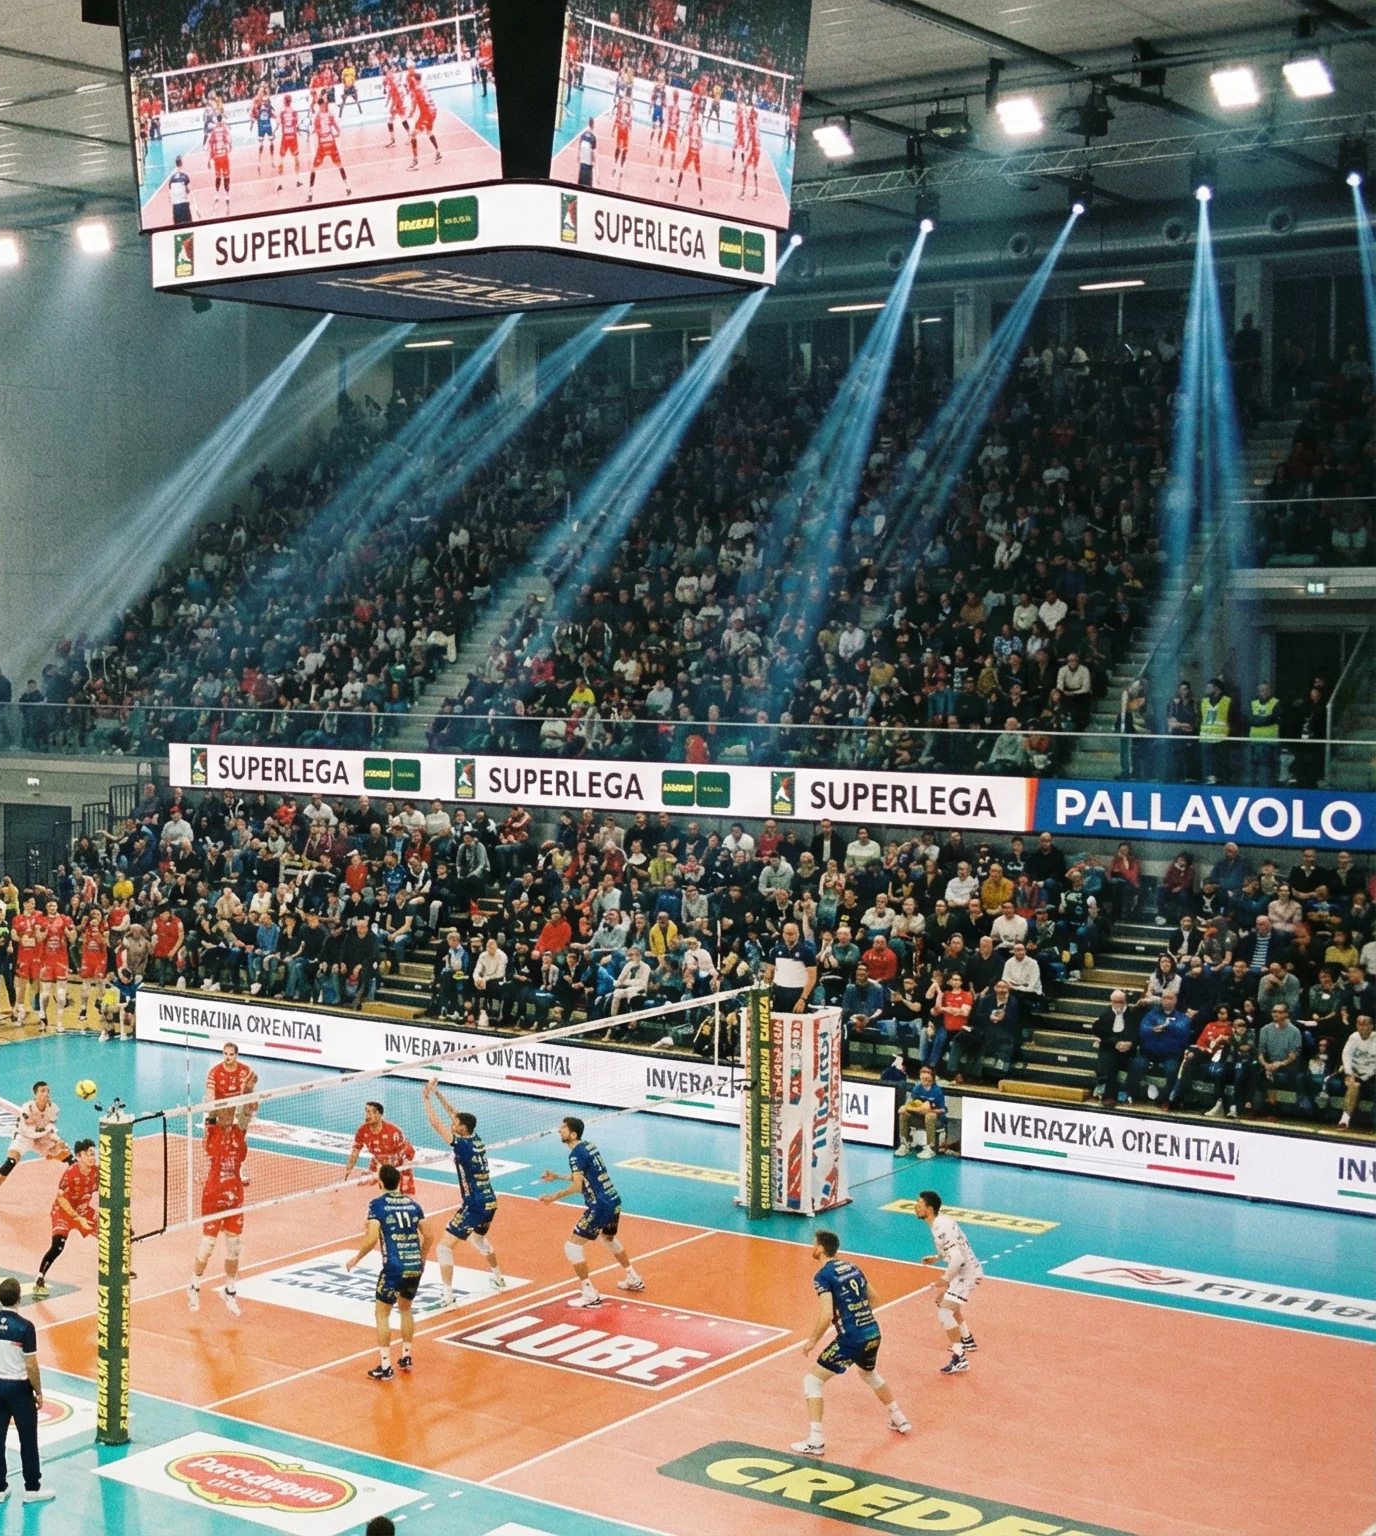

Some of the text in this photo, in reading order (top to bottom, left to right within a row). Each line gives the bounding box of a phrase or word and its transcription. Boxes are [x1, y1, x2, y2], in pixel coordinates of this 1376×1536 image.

[214, 218, 375, 266] SUPERLEGA
[593, 210, 706, 260] SUPERLEGA
[218, 755, 349, 785] SUPERLEGA
[489, 766, 644, 800] SUPERLEGA
[809, 781, 997, 818] SUPERLEGA
[1056, 788, 1363, 840] PALLAVOLO
[395, 1211, 411, 1228] 11
[463, 1316, 712, 1381] LUBE
